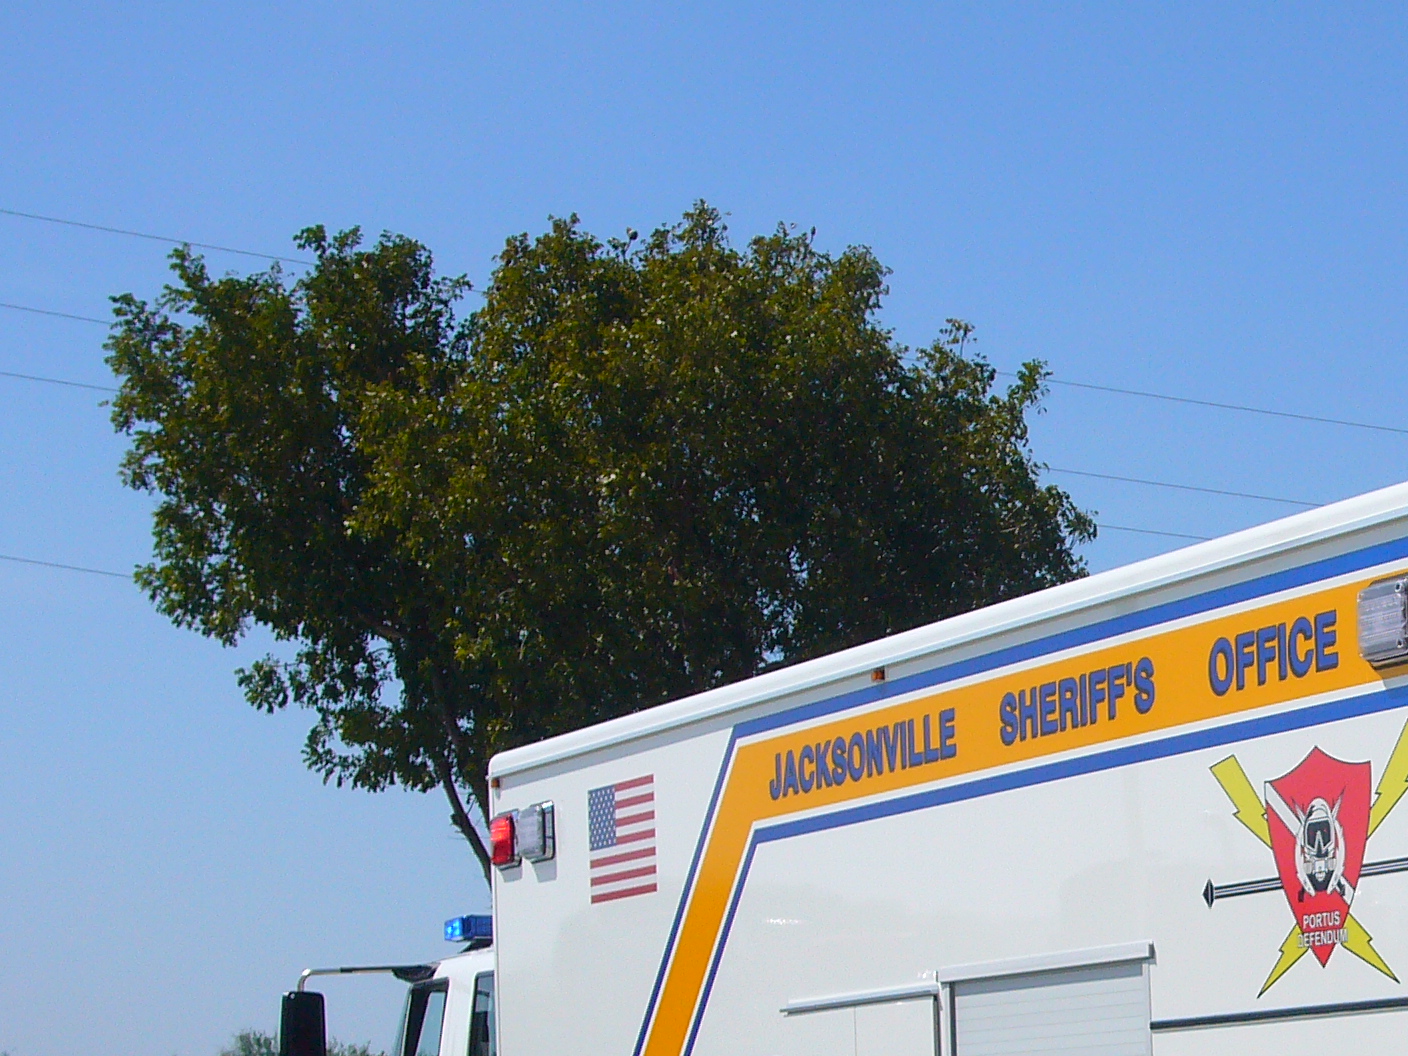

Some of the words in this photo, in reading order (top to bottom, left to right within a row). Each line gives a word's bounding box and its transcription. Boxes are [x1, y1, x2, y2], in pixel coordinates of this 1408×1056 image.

[768, 707, 957, 800] JACKSONVILLE
[999, 656, 1156, 746] SHERIFF'S
[1207, 609, 1340, 697] OFFICE
[1302, 911, 1341, 930] PORTUS
[1297, 929, 1348, 949] DEFENDUM
